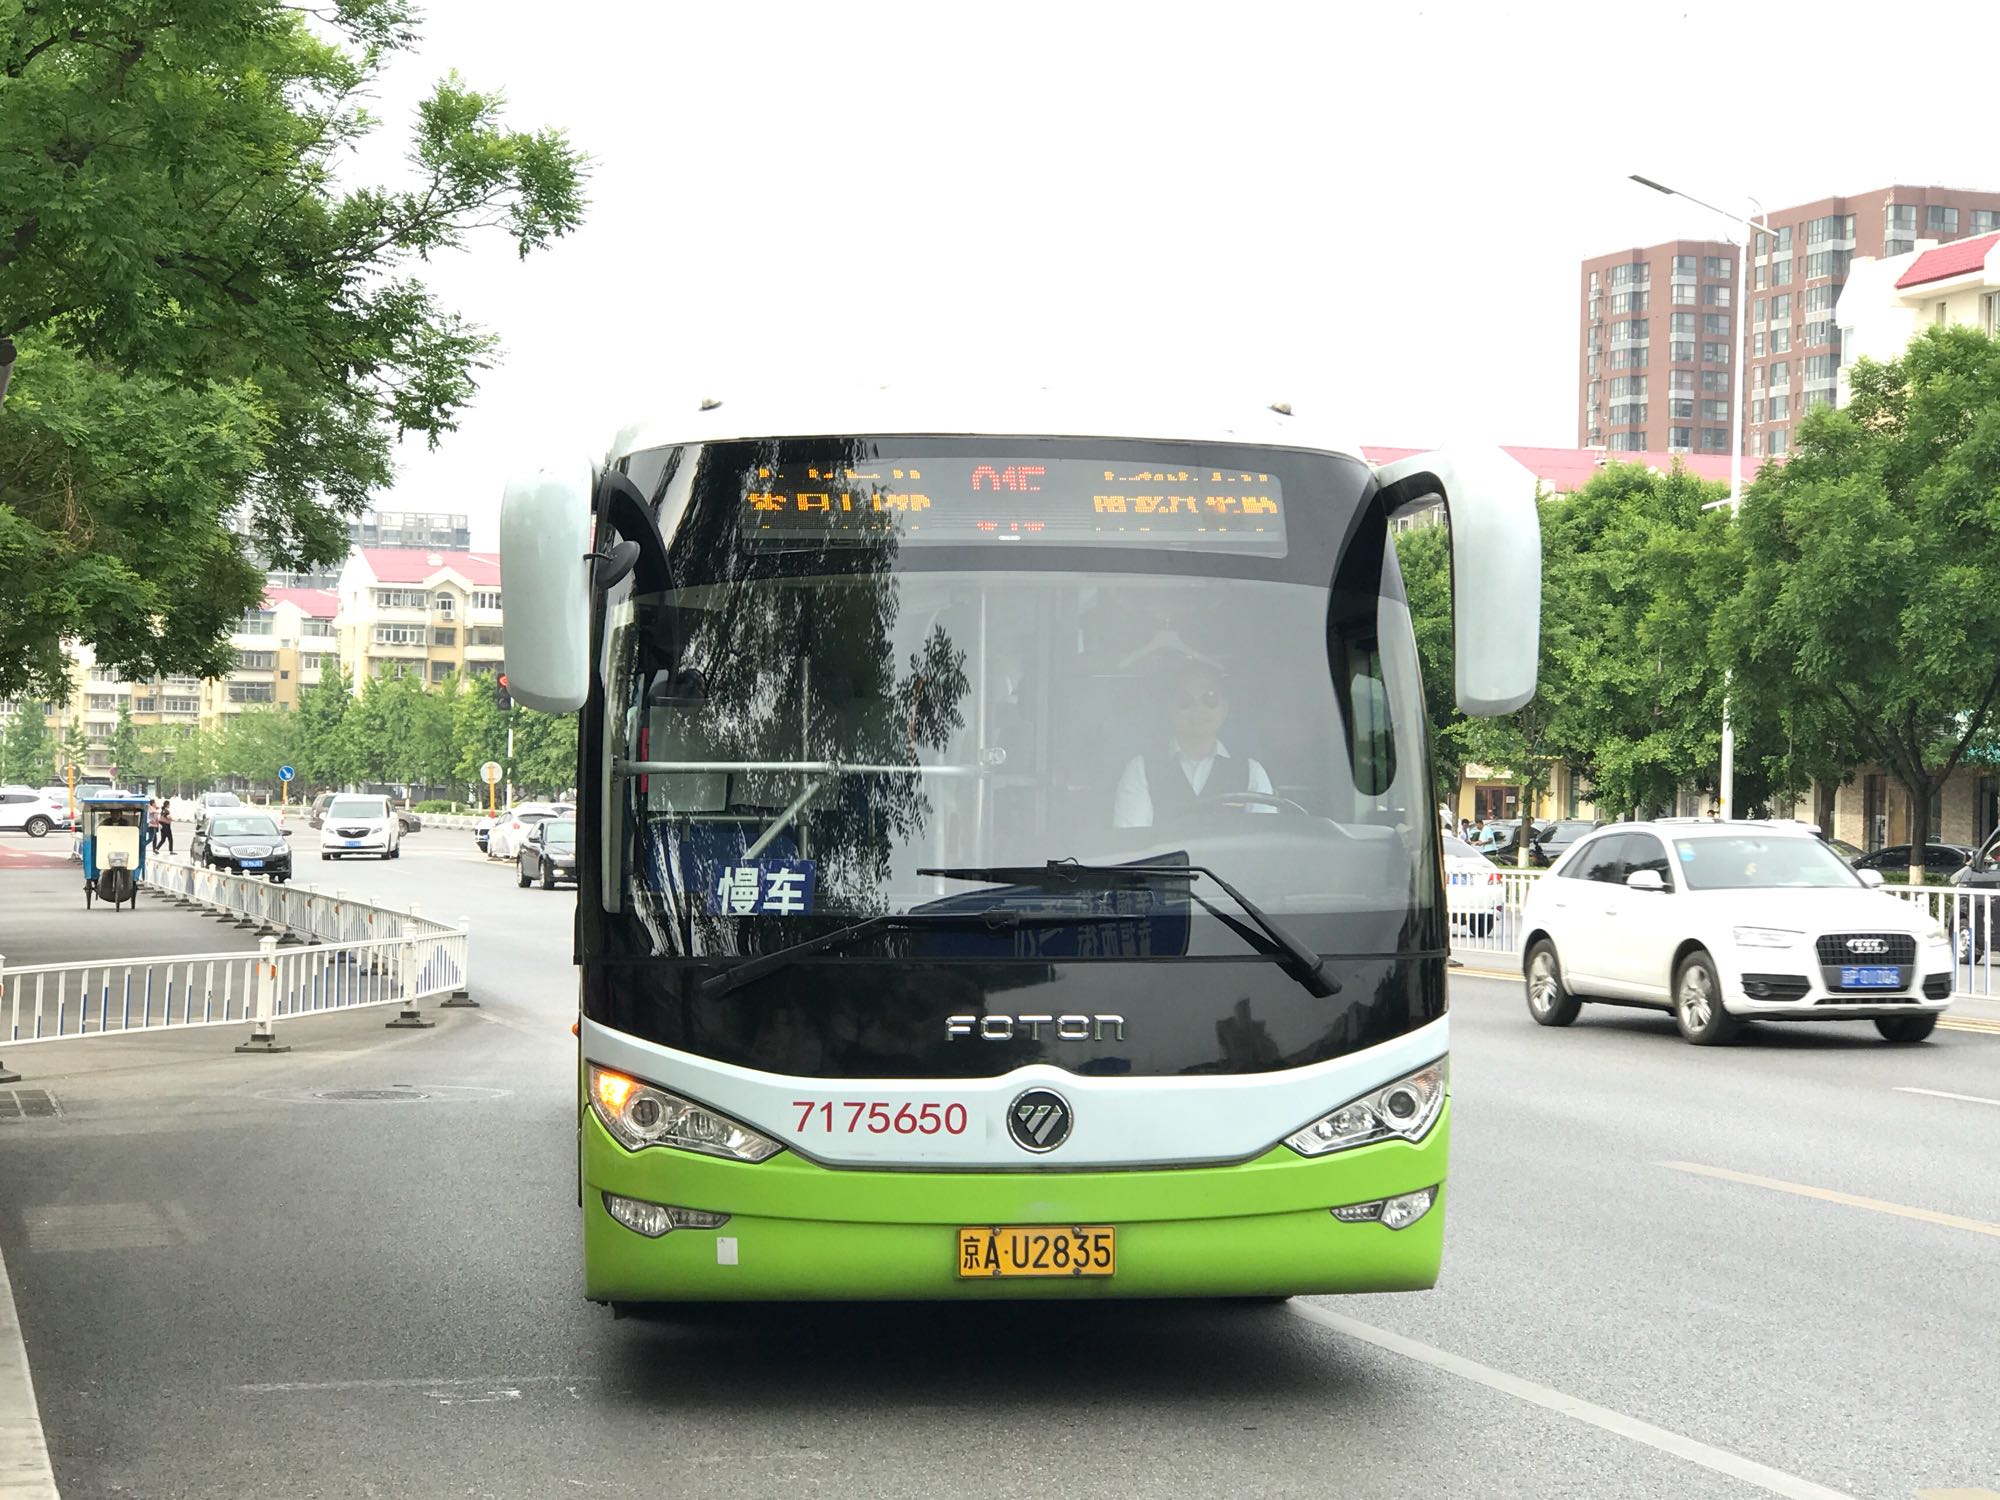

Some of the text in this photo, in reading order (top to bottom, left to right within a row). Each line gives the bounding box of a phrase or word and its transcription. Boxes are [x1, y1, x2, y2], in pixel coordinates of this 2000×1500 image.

[717, 866, 806, 916] 慢车
[944, 1014, 1124, 1041] FOTON
[792, 1101, 968, 1135] 7175650
